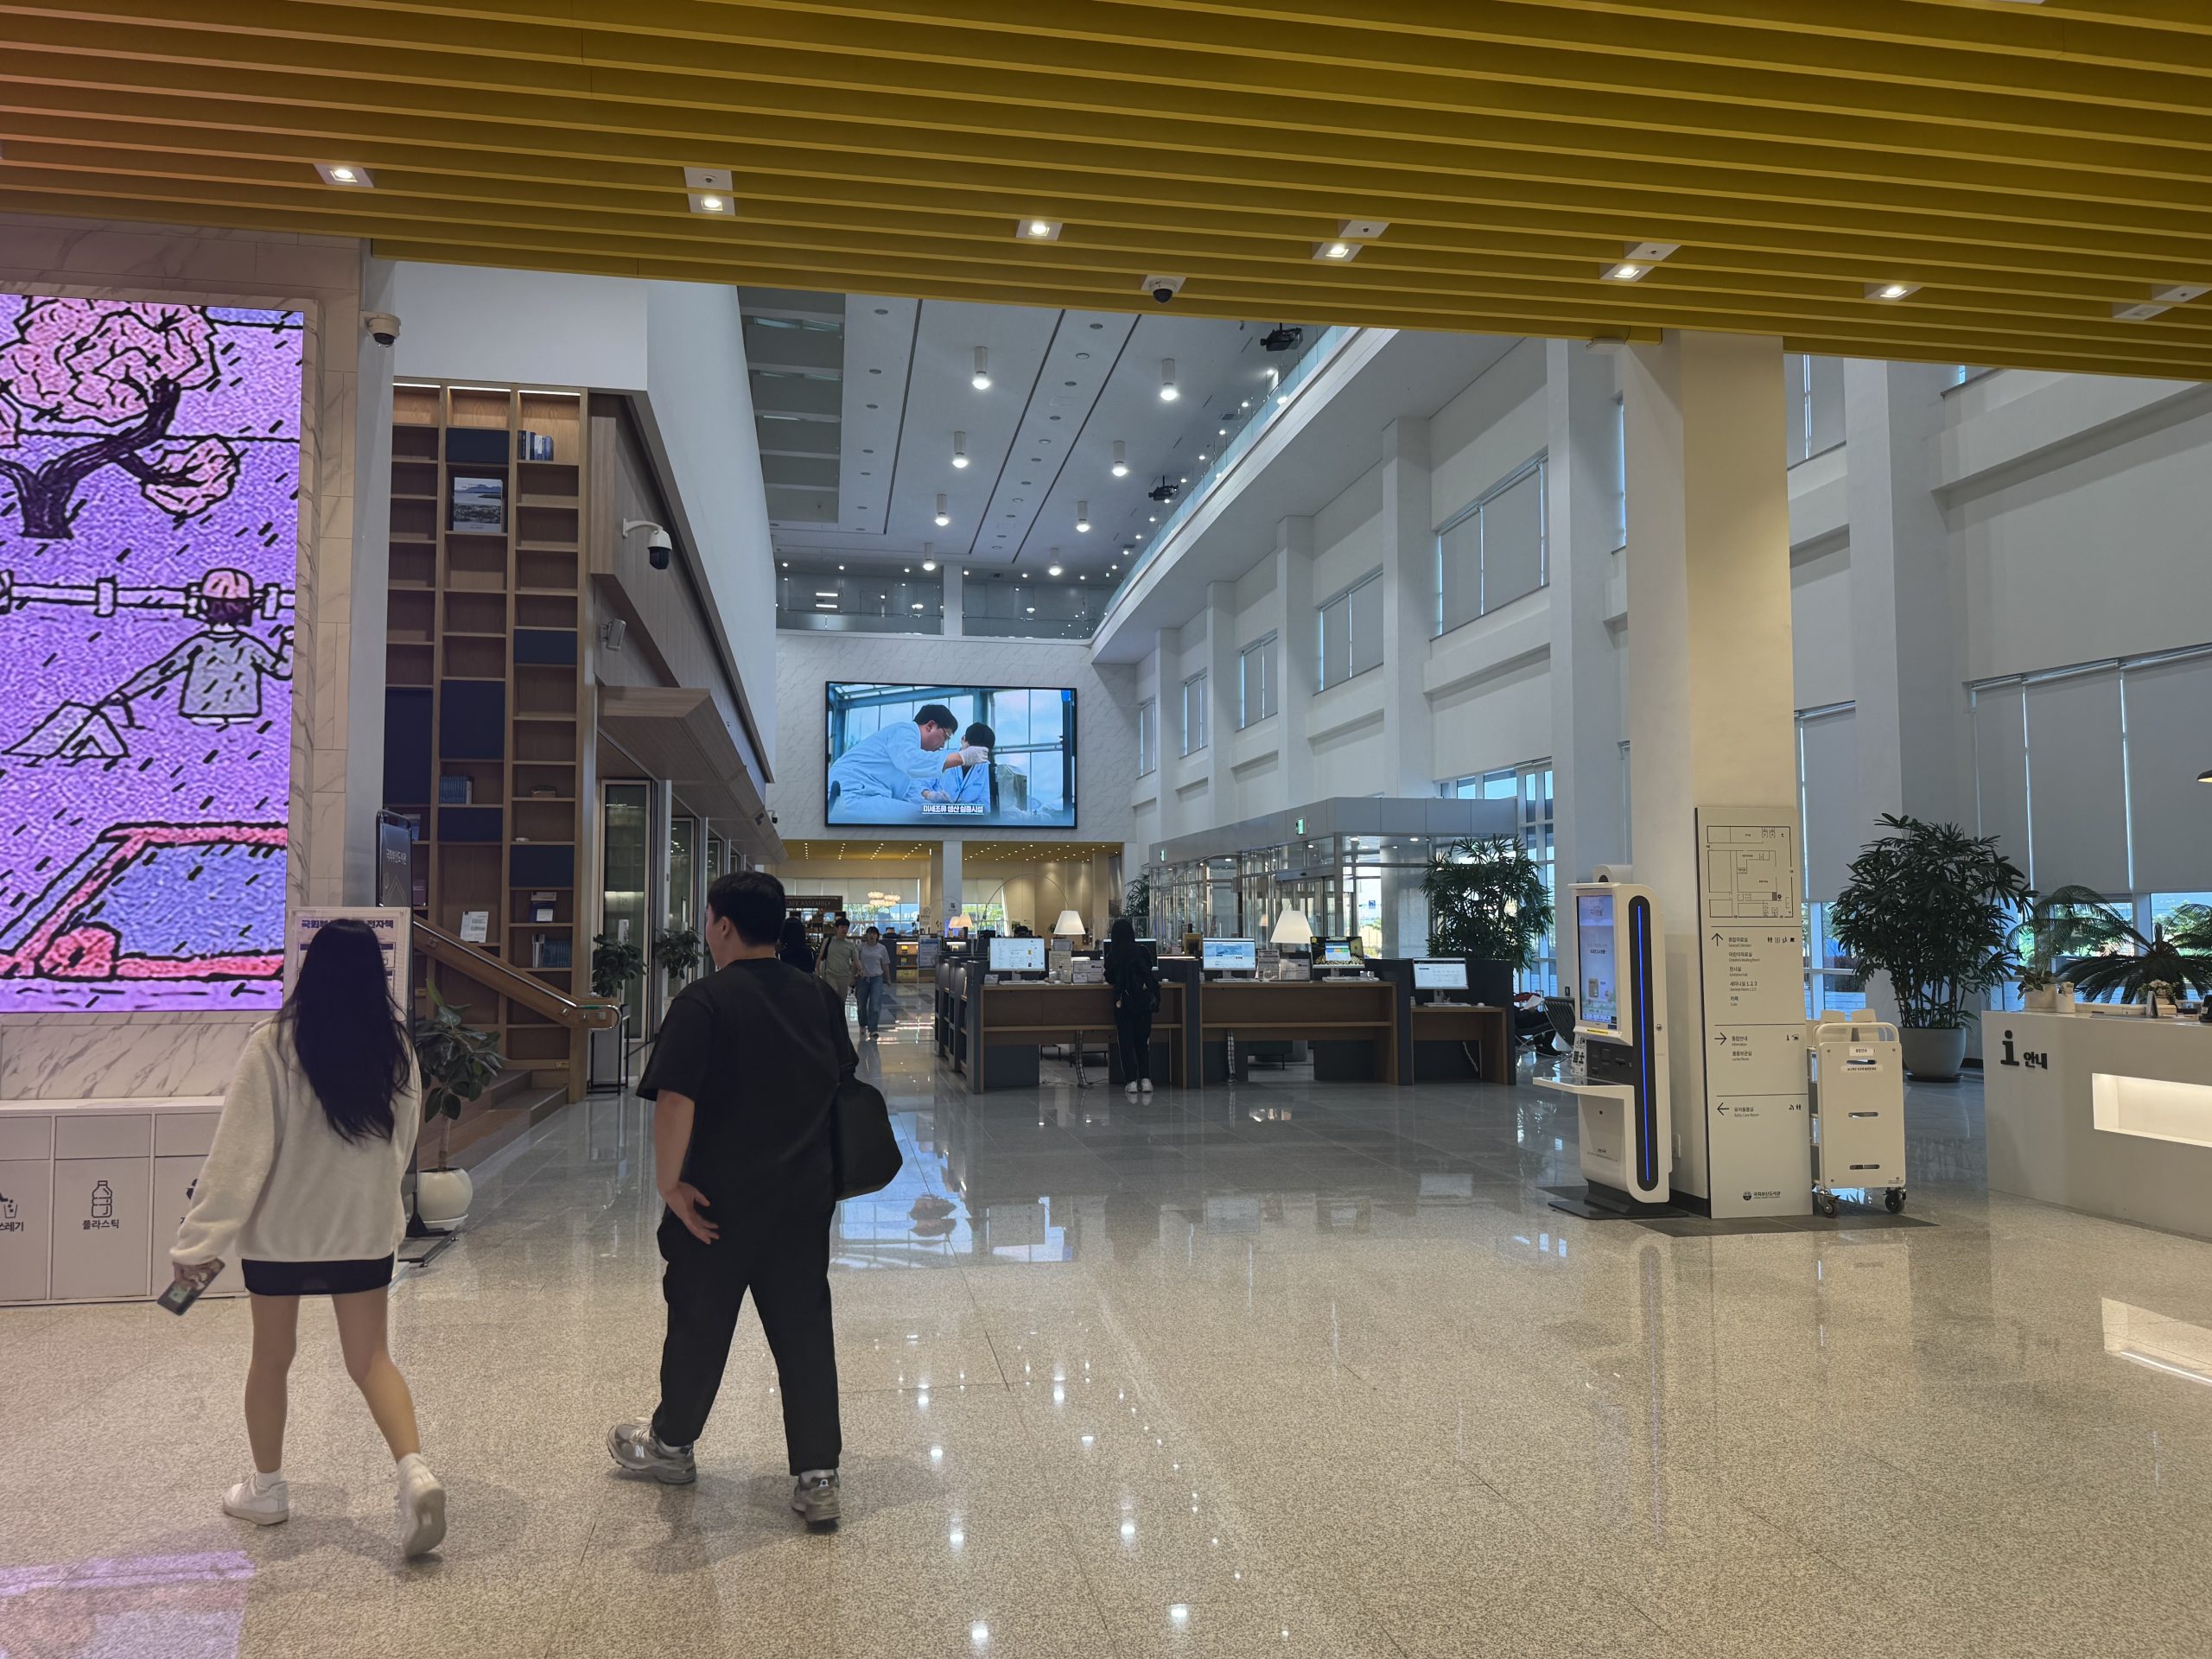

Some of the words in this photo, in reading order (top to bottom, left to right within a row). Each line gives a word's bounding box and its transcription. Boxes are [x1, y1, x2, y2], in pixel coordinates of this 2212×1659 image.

[947, 804, 959, 813] 생산
[2023, 1051, 2048, 1070] 안내
[82, 1218, 120, 1230] 플라스틱
